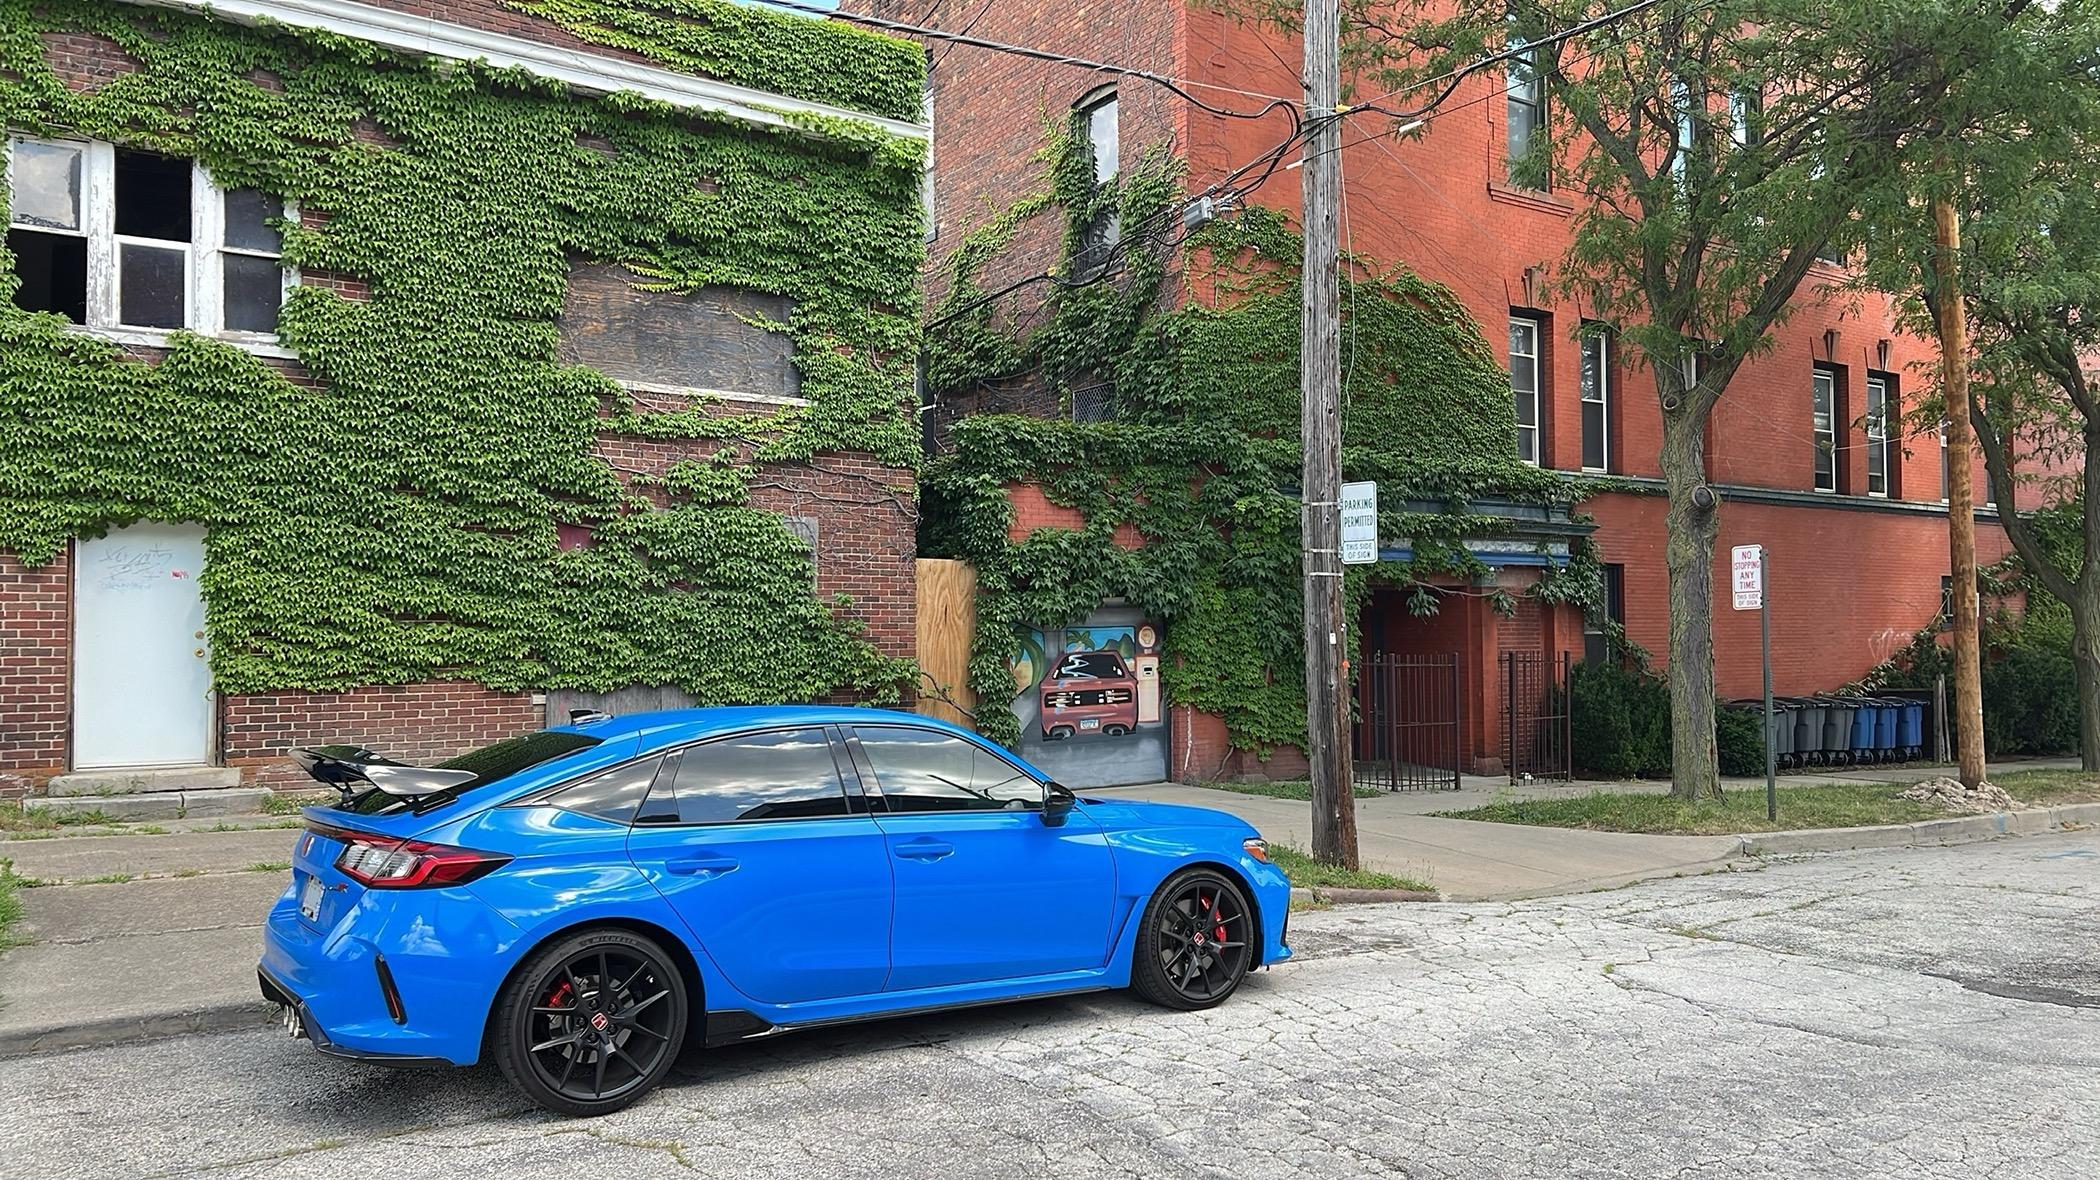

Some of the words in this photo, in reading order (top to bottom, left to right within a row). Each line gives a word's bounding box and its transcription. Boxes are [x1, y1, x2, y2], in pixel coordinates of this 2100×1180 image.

[1344, 498, 1373, 510] PARKING
[1344, 515, 1373, 528] PERMITTED
[1357, 551, 1371, 559] SIGN
[1741, 551, 1752, 560] NO
[1734, 561, 1760, 571] STOPPING
[1740, 571, 1755, 580] ANY
[1740, 581, 1756, 590] TIME
